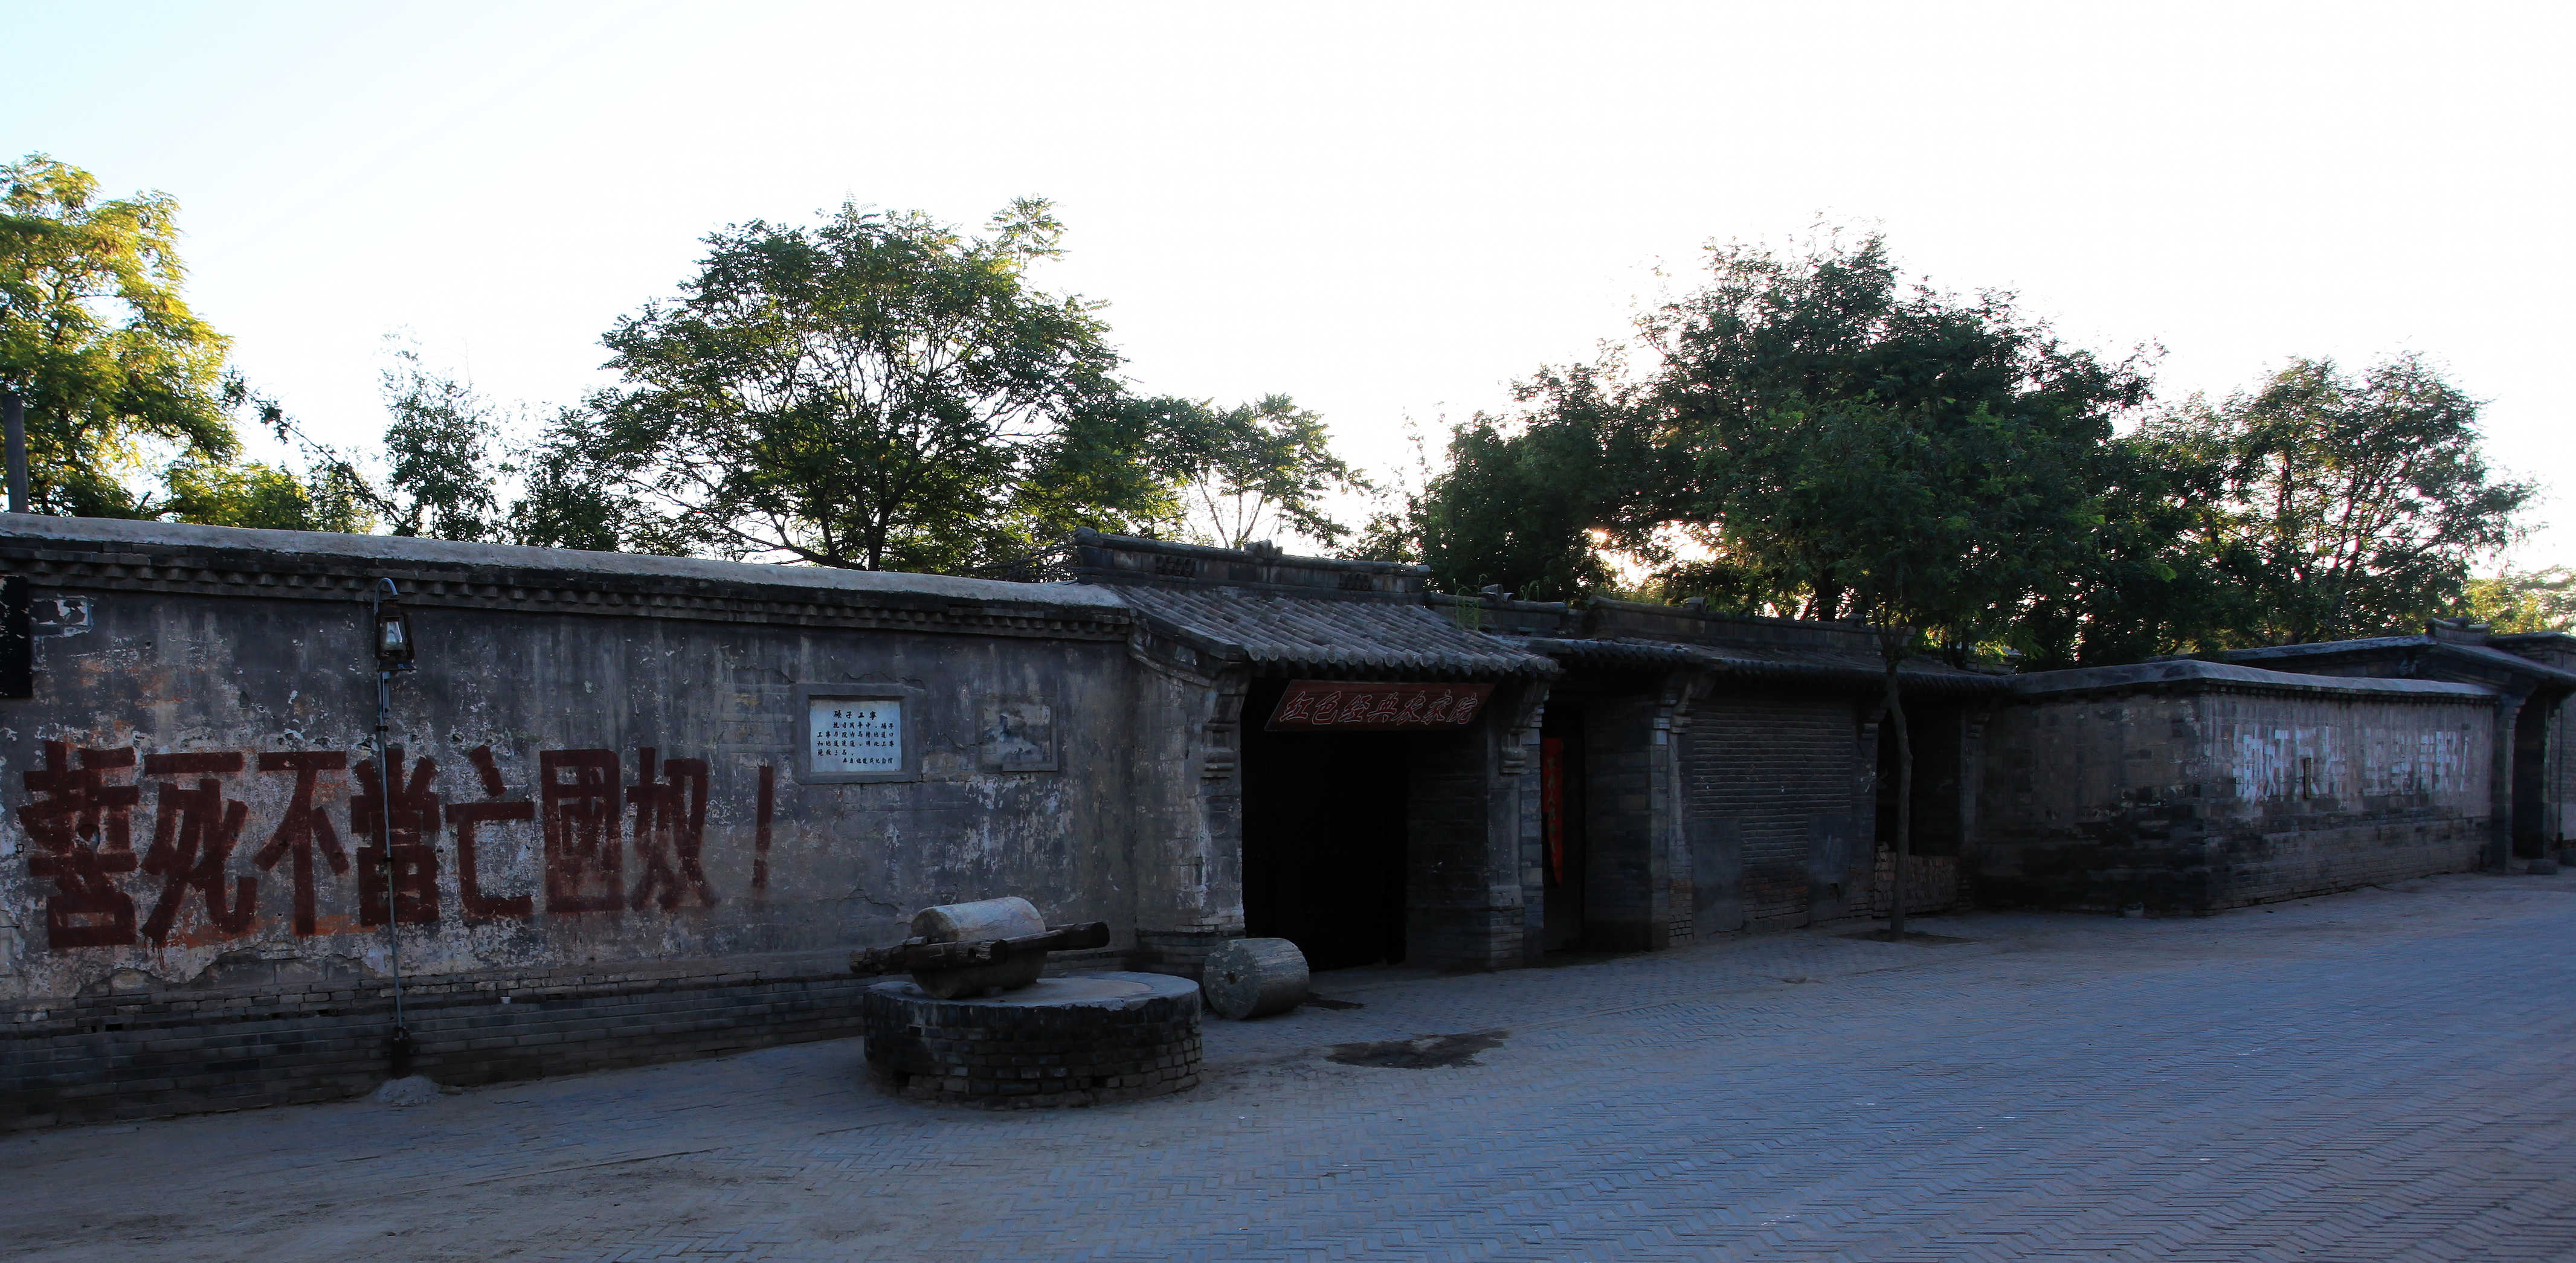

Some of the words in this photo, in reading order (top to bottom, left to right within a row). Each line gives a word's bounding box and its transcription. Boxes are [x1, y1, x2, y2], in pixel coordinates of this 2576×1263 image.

[1280, 689, 1480, 726] 红色经典农家院
